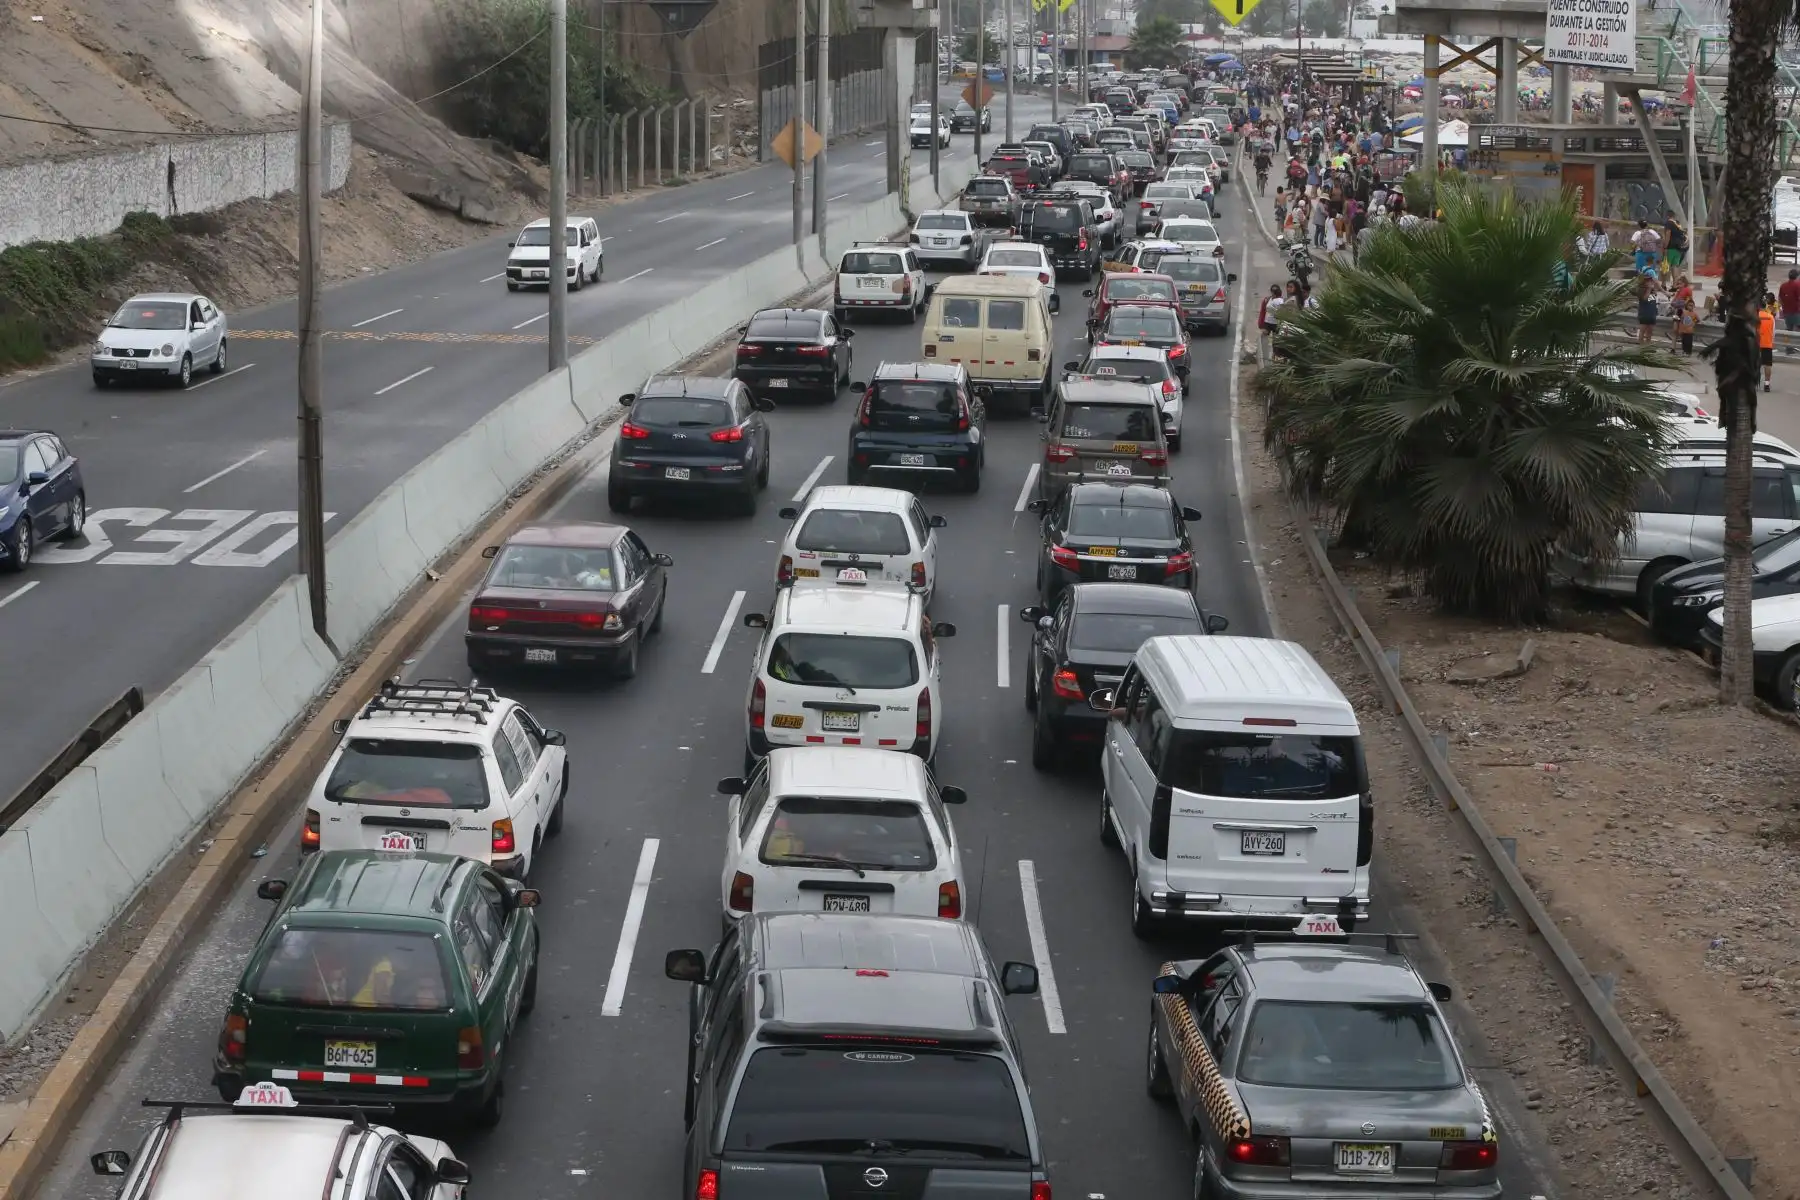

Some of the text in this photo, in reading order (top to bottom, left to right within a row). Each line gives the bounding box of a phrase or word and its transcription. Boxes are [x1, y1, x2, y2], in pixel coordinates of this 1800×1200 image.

[1549, 0, 1630, 15] PUENTE CONSTRUIDO
[1550, 15, 1627, 32] DURANTE LA GESTIÓN
[1568, 32, 1608, 48] 2011-2014
[1549, 49, 1556, 58] EN
[1557, 50, 1583, 61] ARBITRAJE
[1589, 53, 1628, 64] JUDICIALIZADO
[843, 571, 863, 580] TAXI
[381, 837, 410, 850] TAXI
[1244, 837, 1282, 850] AYY-260
[1307, 922, 1336, 933] TAXI
[327, 1048, 374, 1063] B6M-625
[248, 1090, 285, 1105] TAXI
[1341, 1151, 1390, 1166] D1B-278
